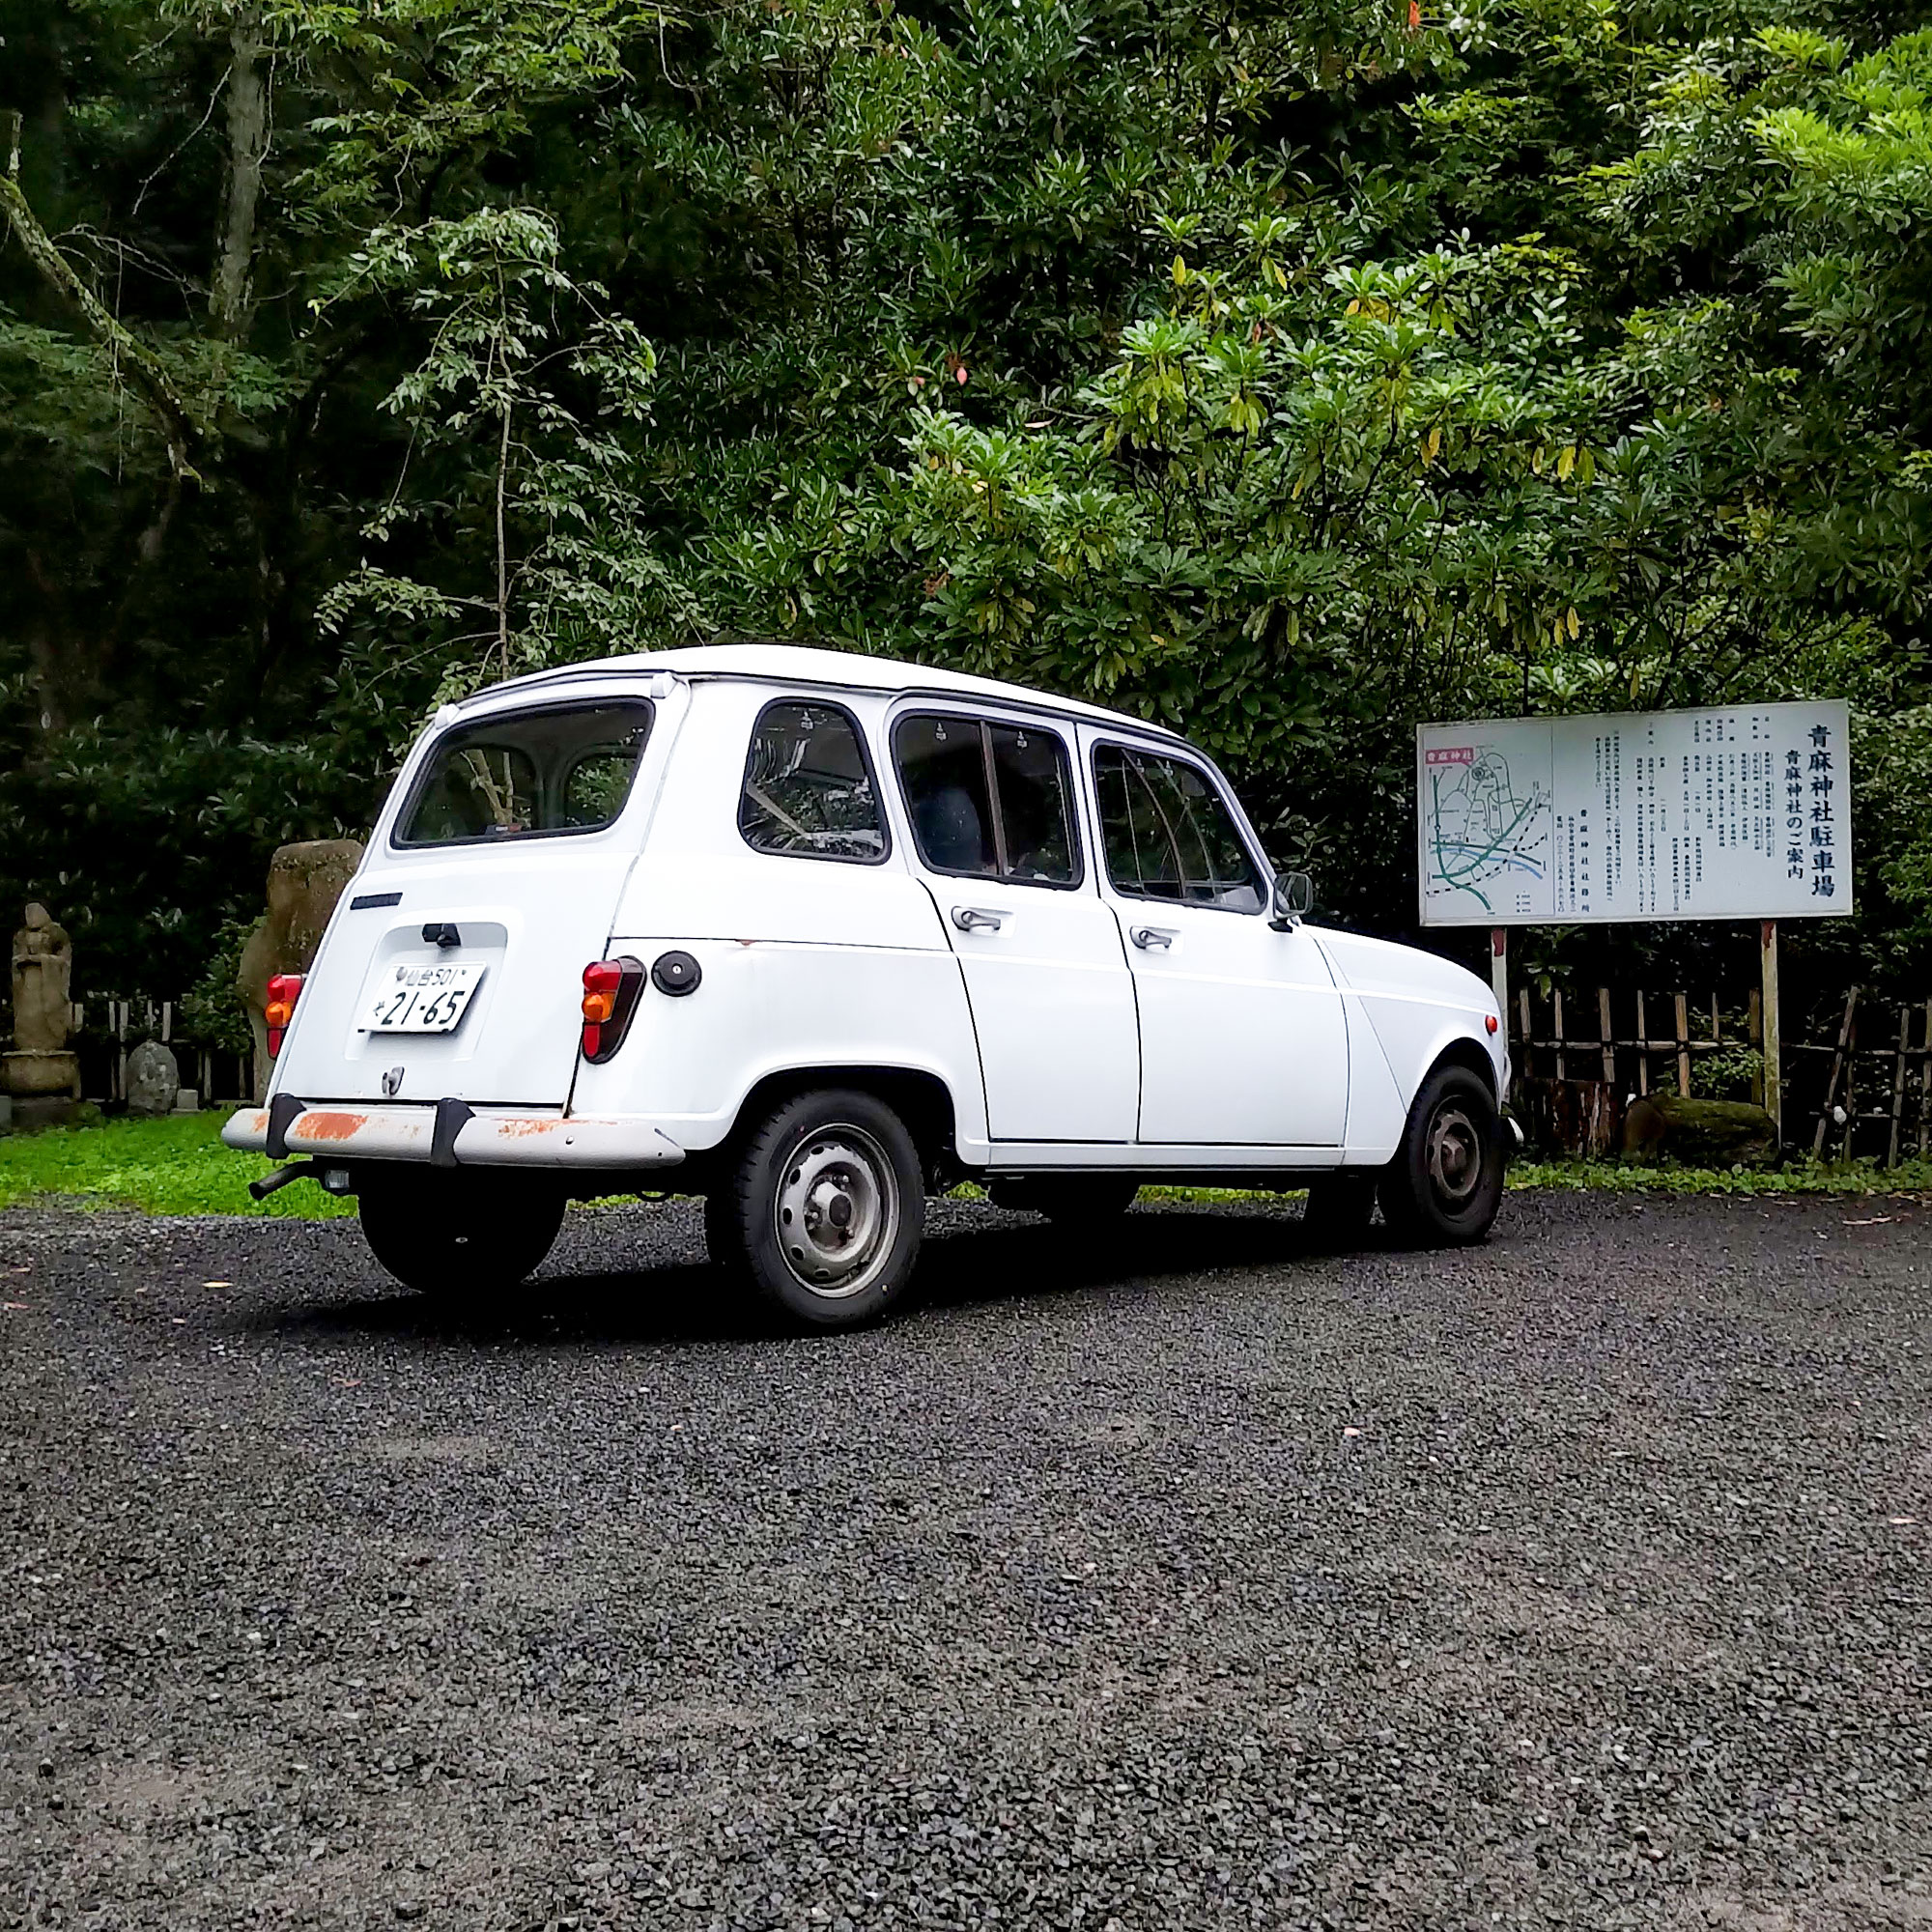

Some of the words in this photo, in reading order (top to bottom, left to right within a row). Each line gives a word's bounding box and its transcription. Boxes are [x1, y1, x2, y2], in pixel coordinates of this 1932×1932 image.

[1784, 750, 1804, 879] 青麻神社のご案内
[1807, 724, 1835, 897] 青麻神社駐車場
